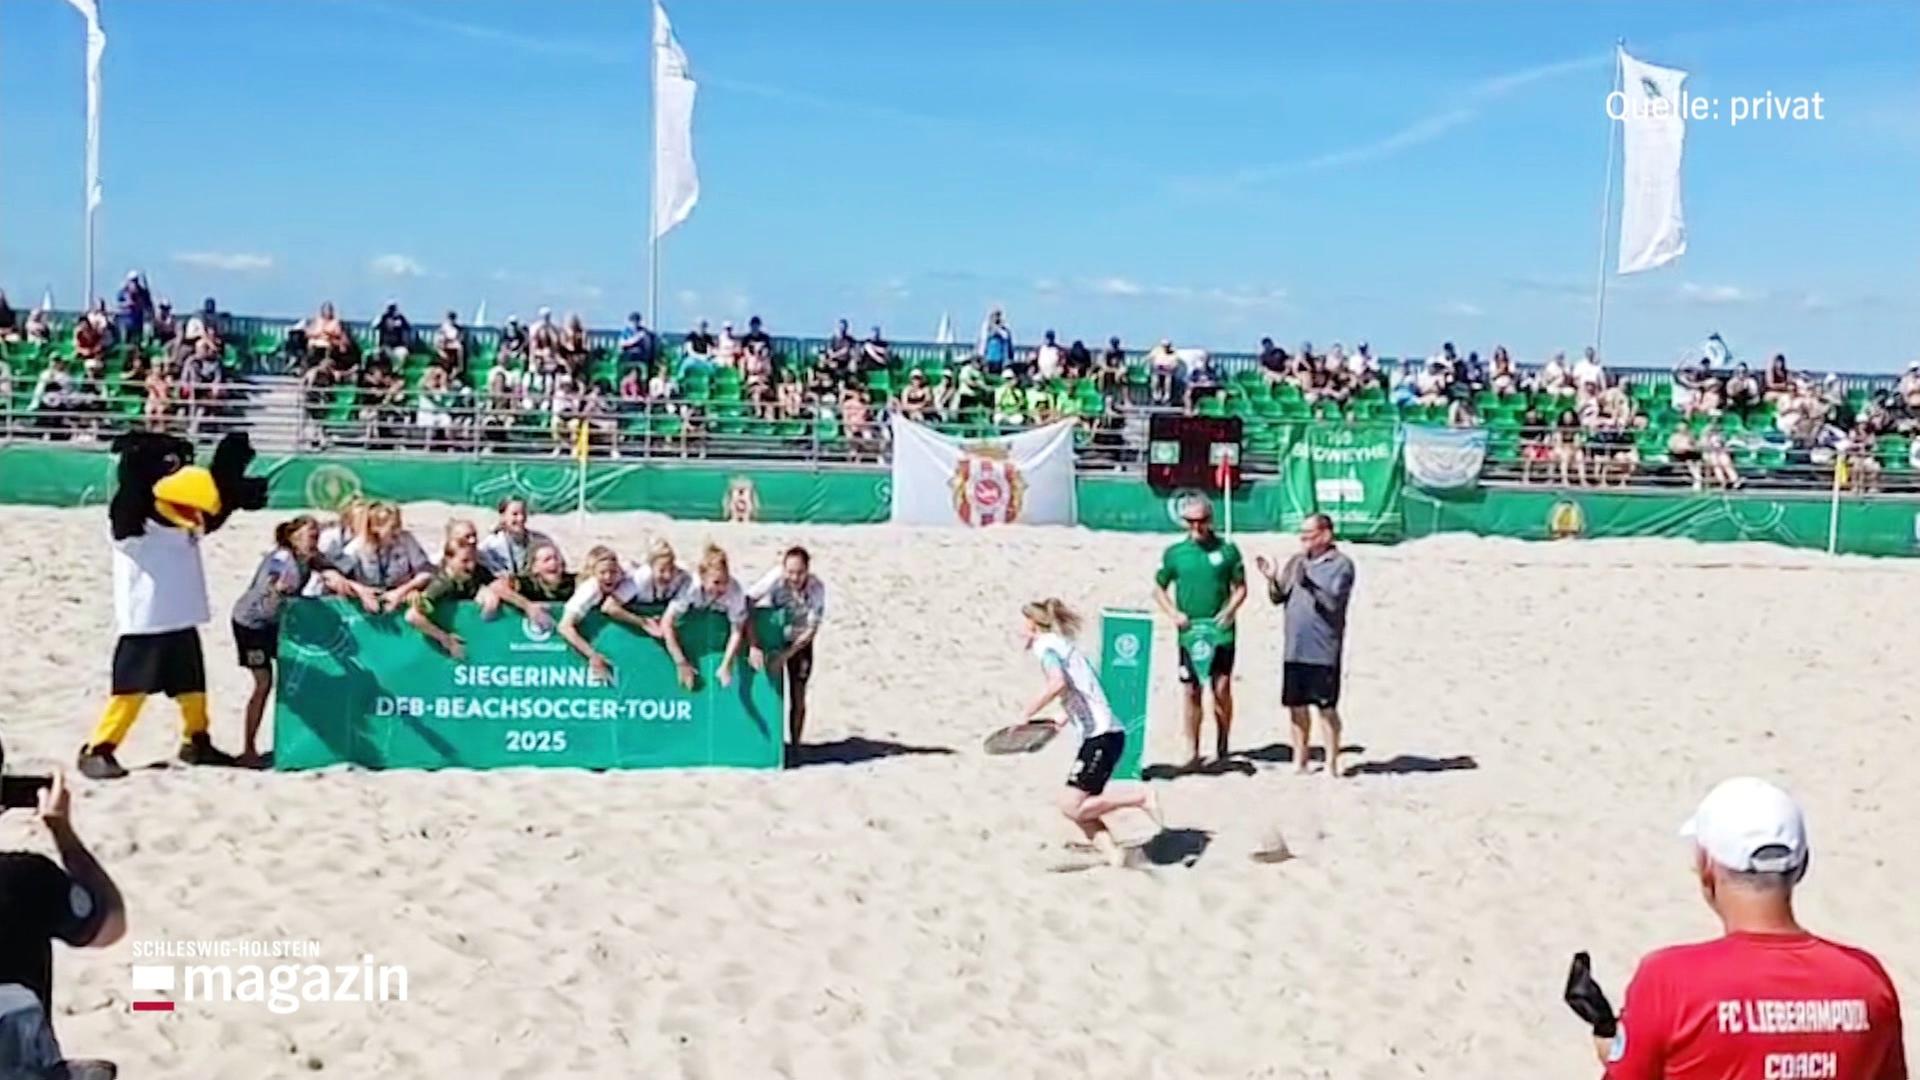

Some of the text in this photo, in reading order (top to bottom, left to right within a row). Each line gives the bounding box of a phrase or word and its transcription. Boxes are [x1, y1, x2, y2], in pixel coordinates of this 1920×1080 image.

[506, 730, 567, 752] 2025
[1718, 1000, 1743, 1034] FC
[1764, 1052, 1838, 1080] COACH
